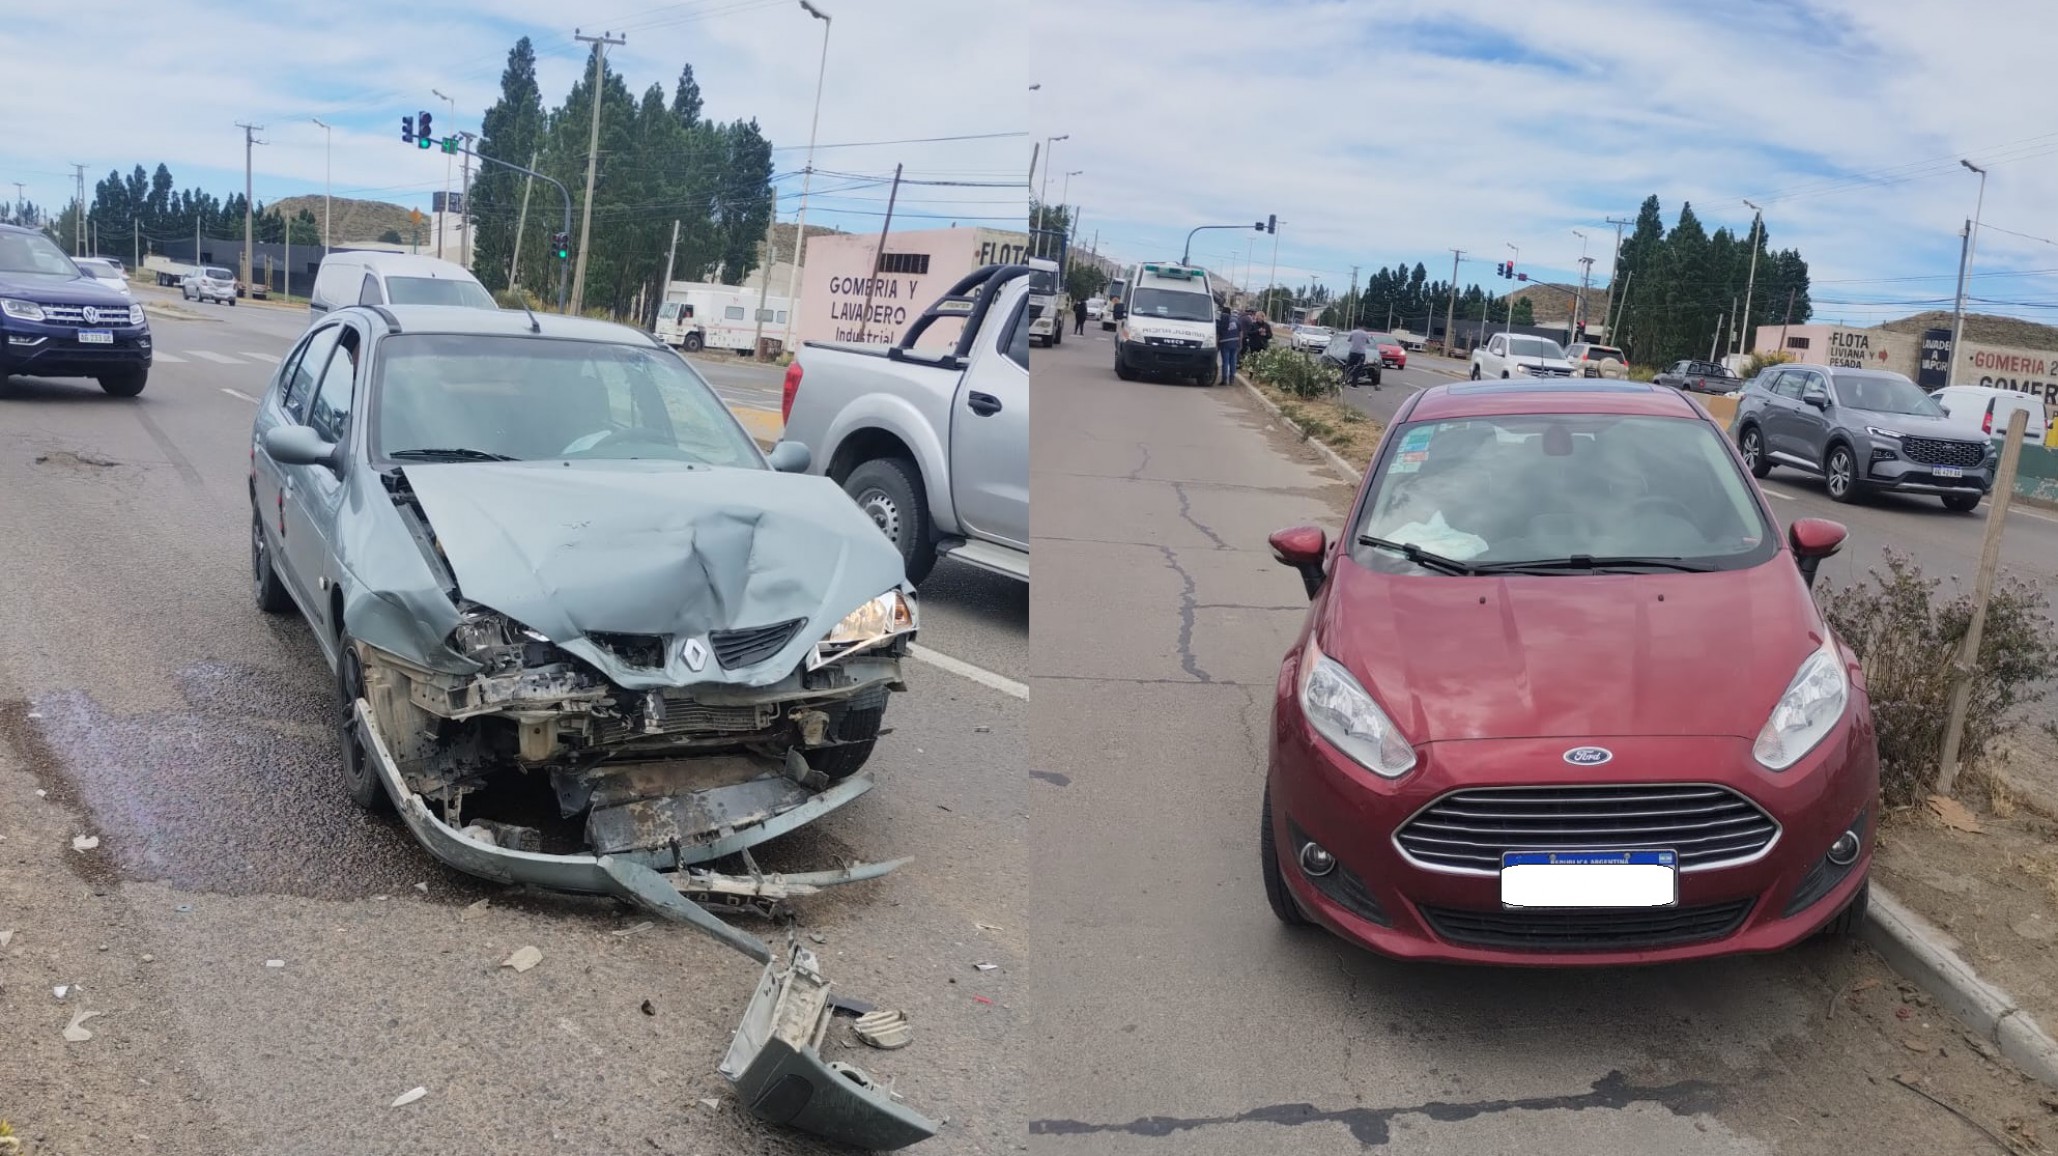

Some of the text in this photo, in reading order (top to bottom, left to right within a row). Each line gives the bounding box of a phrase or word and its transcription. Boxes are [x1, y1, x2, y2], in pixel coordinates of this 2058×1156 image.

[979, 242, 1029, 266] FLOTA
[829, 276, 918, 300] GOMERIA Y
[831, 301, 906, 325] LAVADERO
[1832, 331, 1869, 349] FLOTA
[1830, 347, 1865, 360] LIVIANA
[1830, 357, 1862, 370] PESADA
[1931, 350, 1938, 360] A
[1974, 350, 2045, 375] GOMERIA
